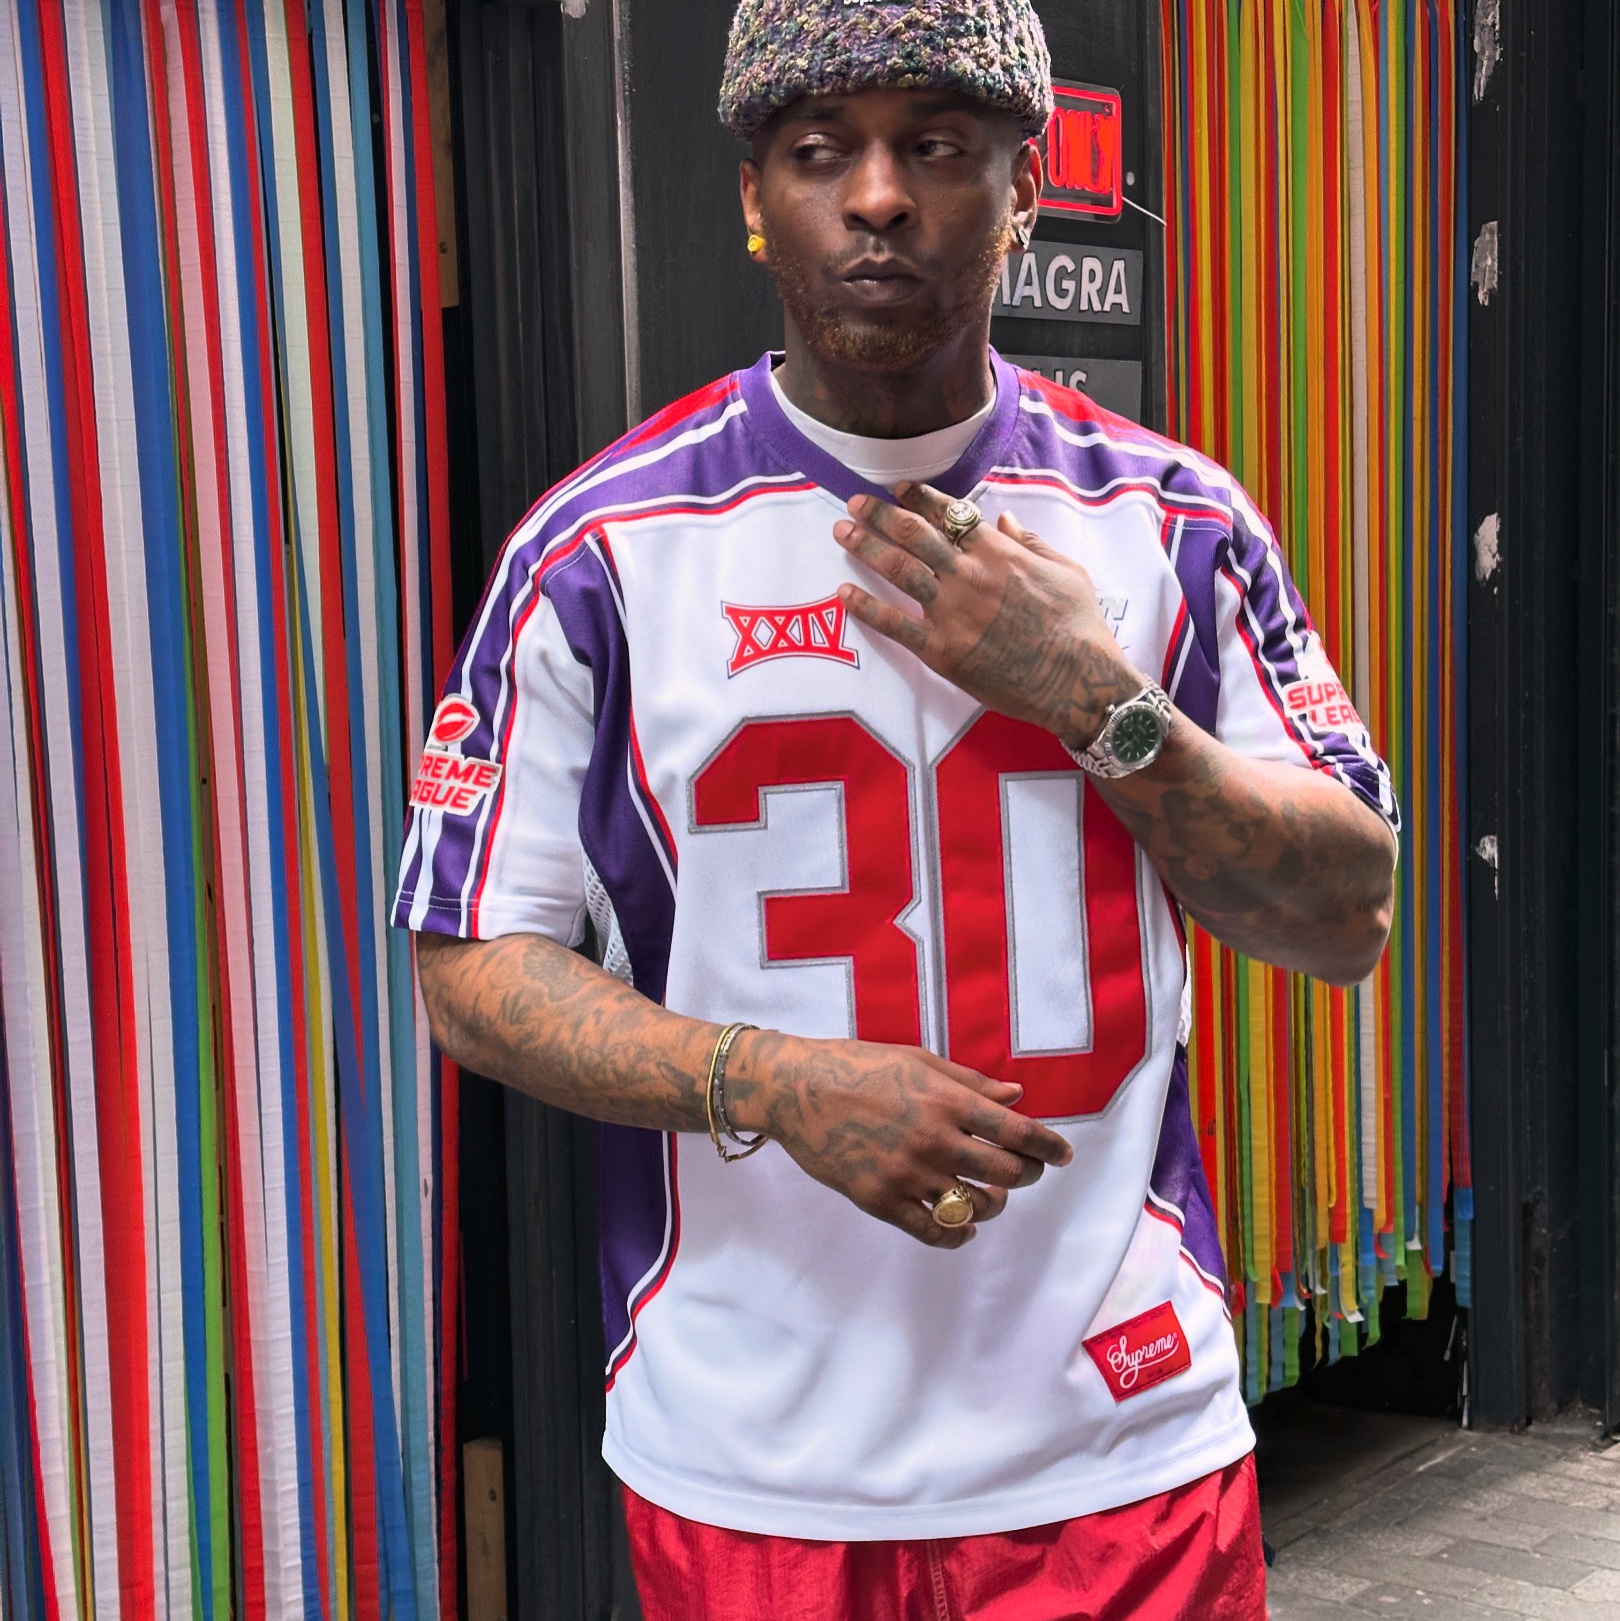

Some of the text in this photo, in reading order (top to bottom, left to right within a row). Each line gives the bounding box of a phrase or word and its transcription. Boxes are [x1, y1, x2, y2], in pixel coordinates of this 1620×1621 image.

[1001, 252, 1130, 313] IAGRA
[720, 592, 860, 680] XXIV
[420, 753, 497, 788] REME
[687, 706, 1152, 1124] 30
[1106, 1334, 1180, 1389] Supreme
